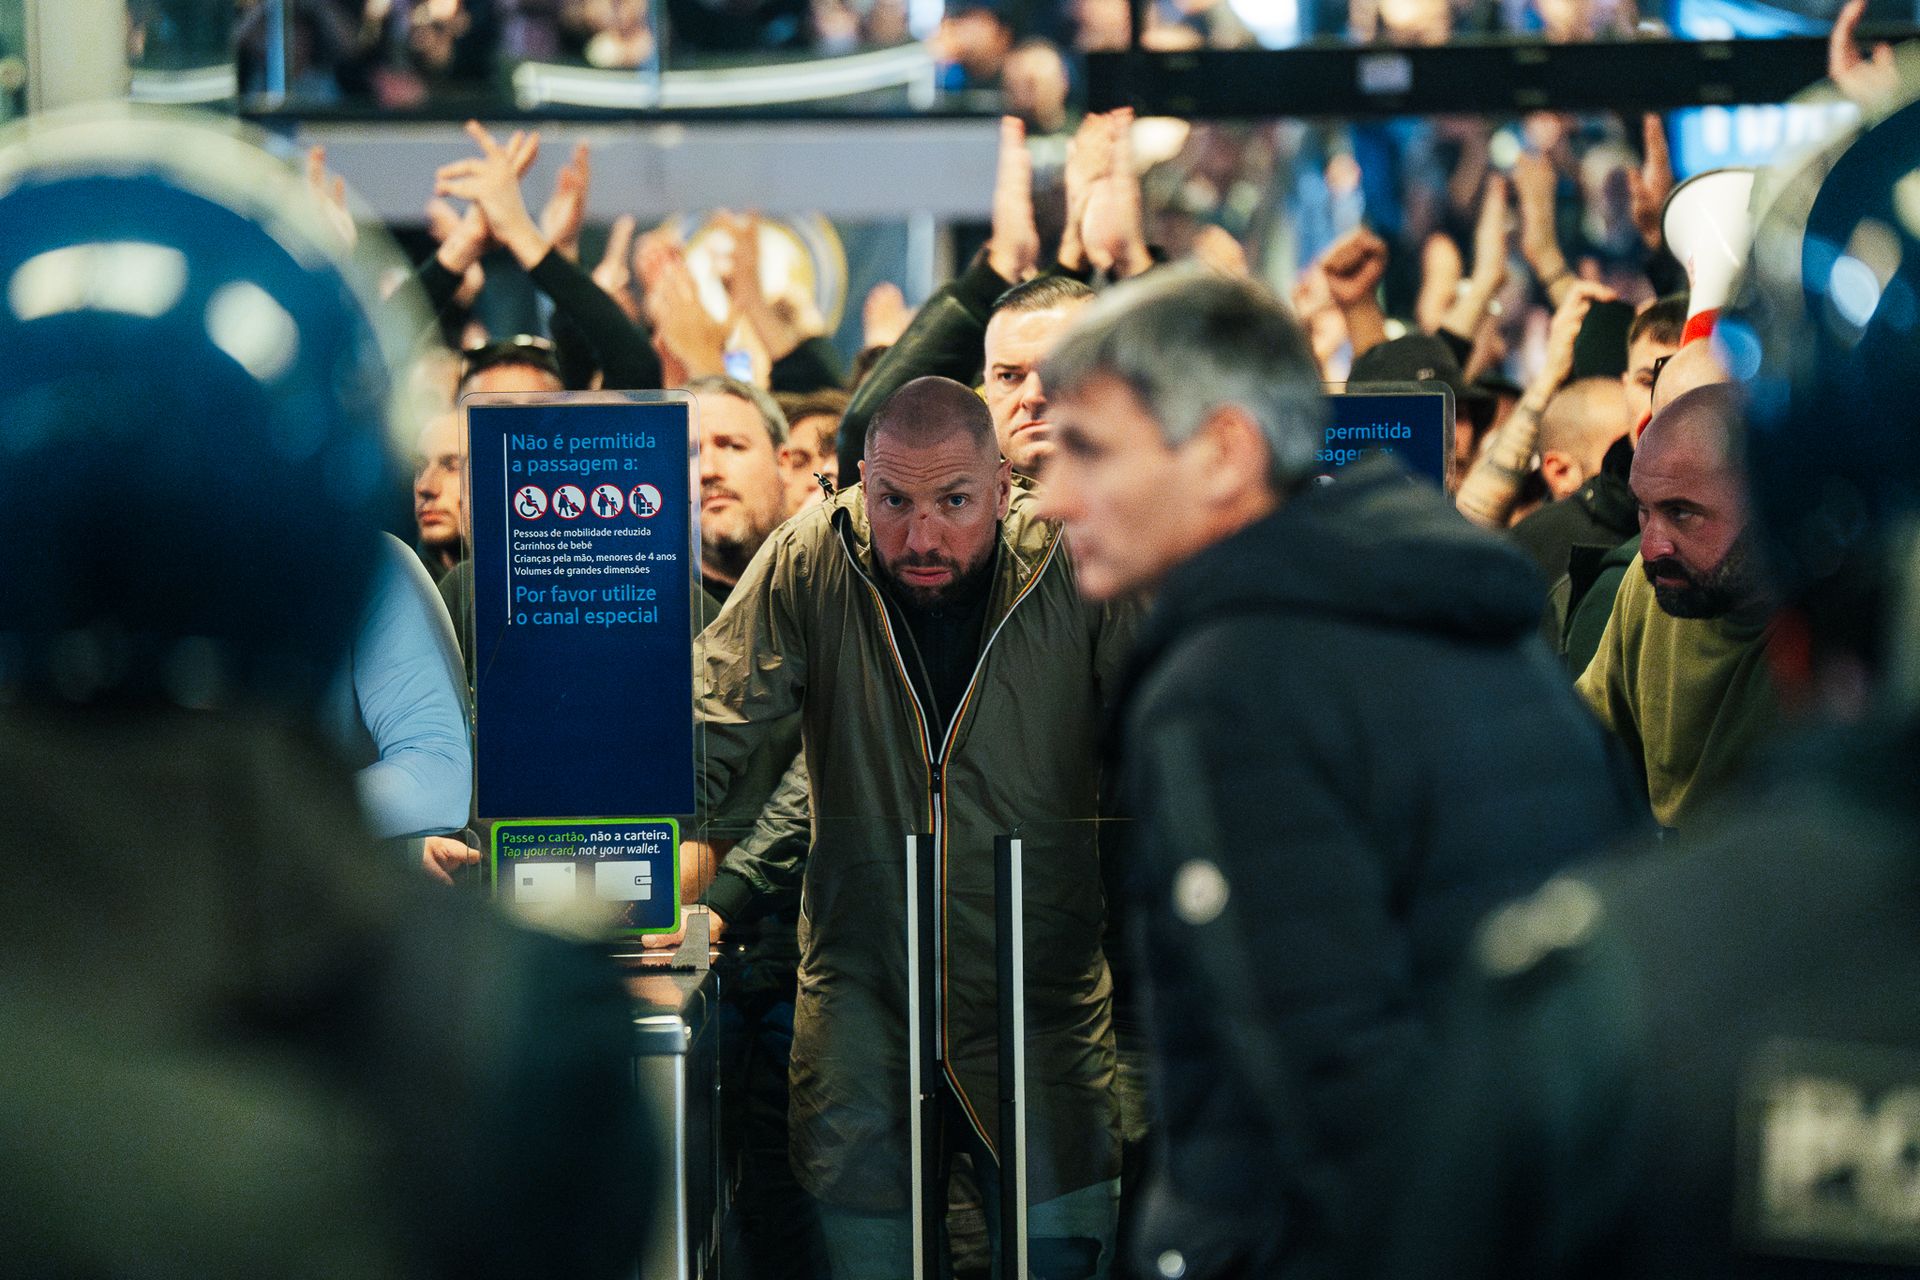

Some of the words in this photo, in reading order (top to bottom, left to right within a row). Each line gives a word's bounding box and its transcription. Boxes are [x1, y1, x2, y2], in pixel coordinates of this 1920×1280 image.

[1326, 422, 1411, 443] permitida
[512, 434, 547, 450] Não
[553, 434, 564, 450] é
[570, 432, 656, 453] permitida
[512, 460, 522, 472] a
[528, 457, 617, 476] passagem
[624, 458, 638, 470] a:
[514, 529, 548, 538] Pessoas
[551, 528, 561, 537] de
[564, 528, 612, 537] mobilidade
[614, 528, 651, 536] reduzida
[514, 542, 555, 550] Carrinhos
[557, 542, 568, 550] de
[571, 541, 592, 549] bebé
[514, 554, 551, 564] Crianças
[553, 554, 571, 564] pela
[573, 554, 594, 562] mão,
[635, 553, 646, 561] de
[648, 553, 654, 561] 4
[514, 567, 551, 576] Volumes
[554, 567, 565, 575] de
[567, 566, 601, 577] grandes
[604, 565, 650, 574] dimensões
[516, 586, 546, 602] Por
[551, 585, 597, 602] favor
[602, 584, 656, 601] utilize
[516, 613, 527, 625] o
[533, 608, 579, 625] canal
[585, 606, 658, 628] especial
[503, 833, 535, 843] Passe
[549, 832, 587, 843] cartão,
[591, 831, 611, 841] não
[614, 833, 621, 841] a
[624, 831, 670, 841] carteira.
[503, 846, 521, 858] Tap
[523, 847, 548, 857] your
[551, 845, 576, 857] card,
[579, 846, 597, 855] not
[600, 846, 624, 857] your
[627, 844, 660, 854] wallet.
